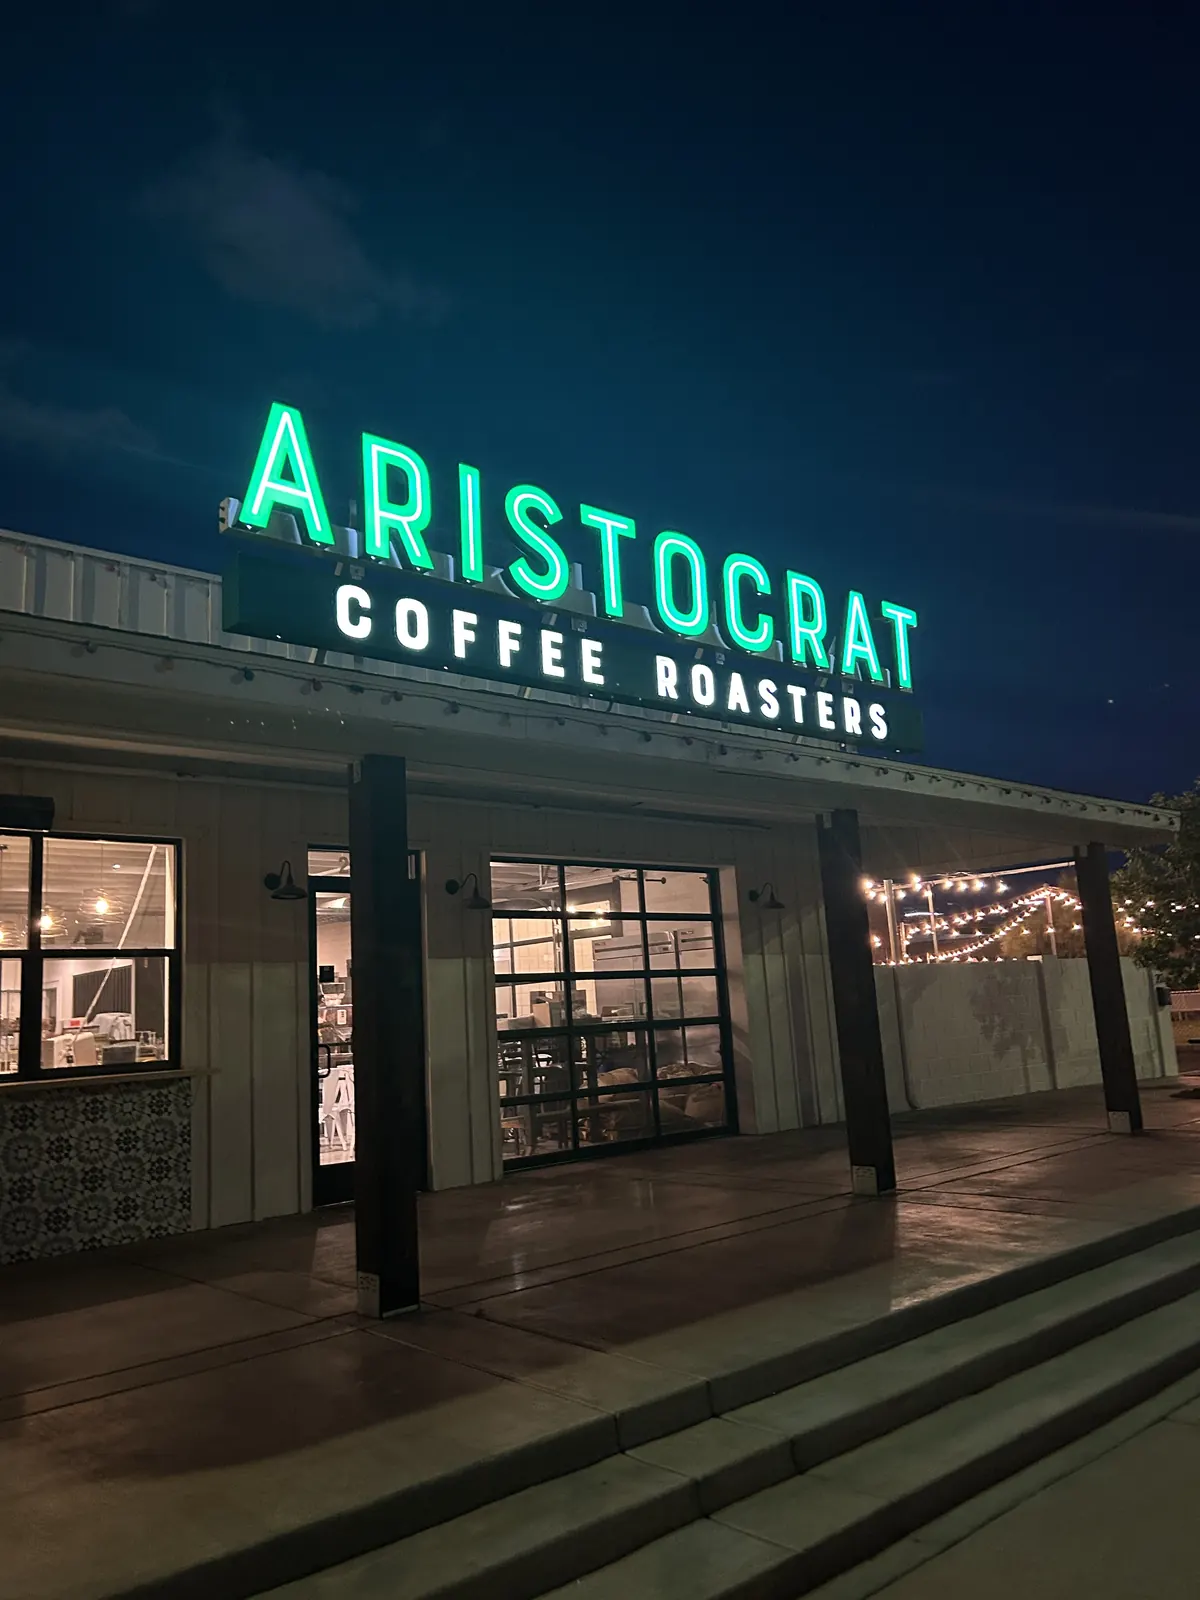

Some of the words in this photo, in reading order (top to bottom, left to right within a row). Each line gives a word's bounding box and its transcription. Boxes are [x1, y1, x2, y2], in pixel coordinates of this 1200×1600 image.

[239, 402, 918, 690] ARISTOCRAT
[335, 584, 605, 686] COFFEE
[655, 655, 889, 740] ROASTERS
